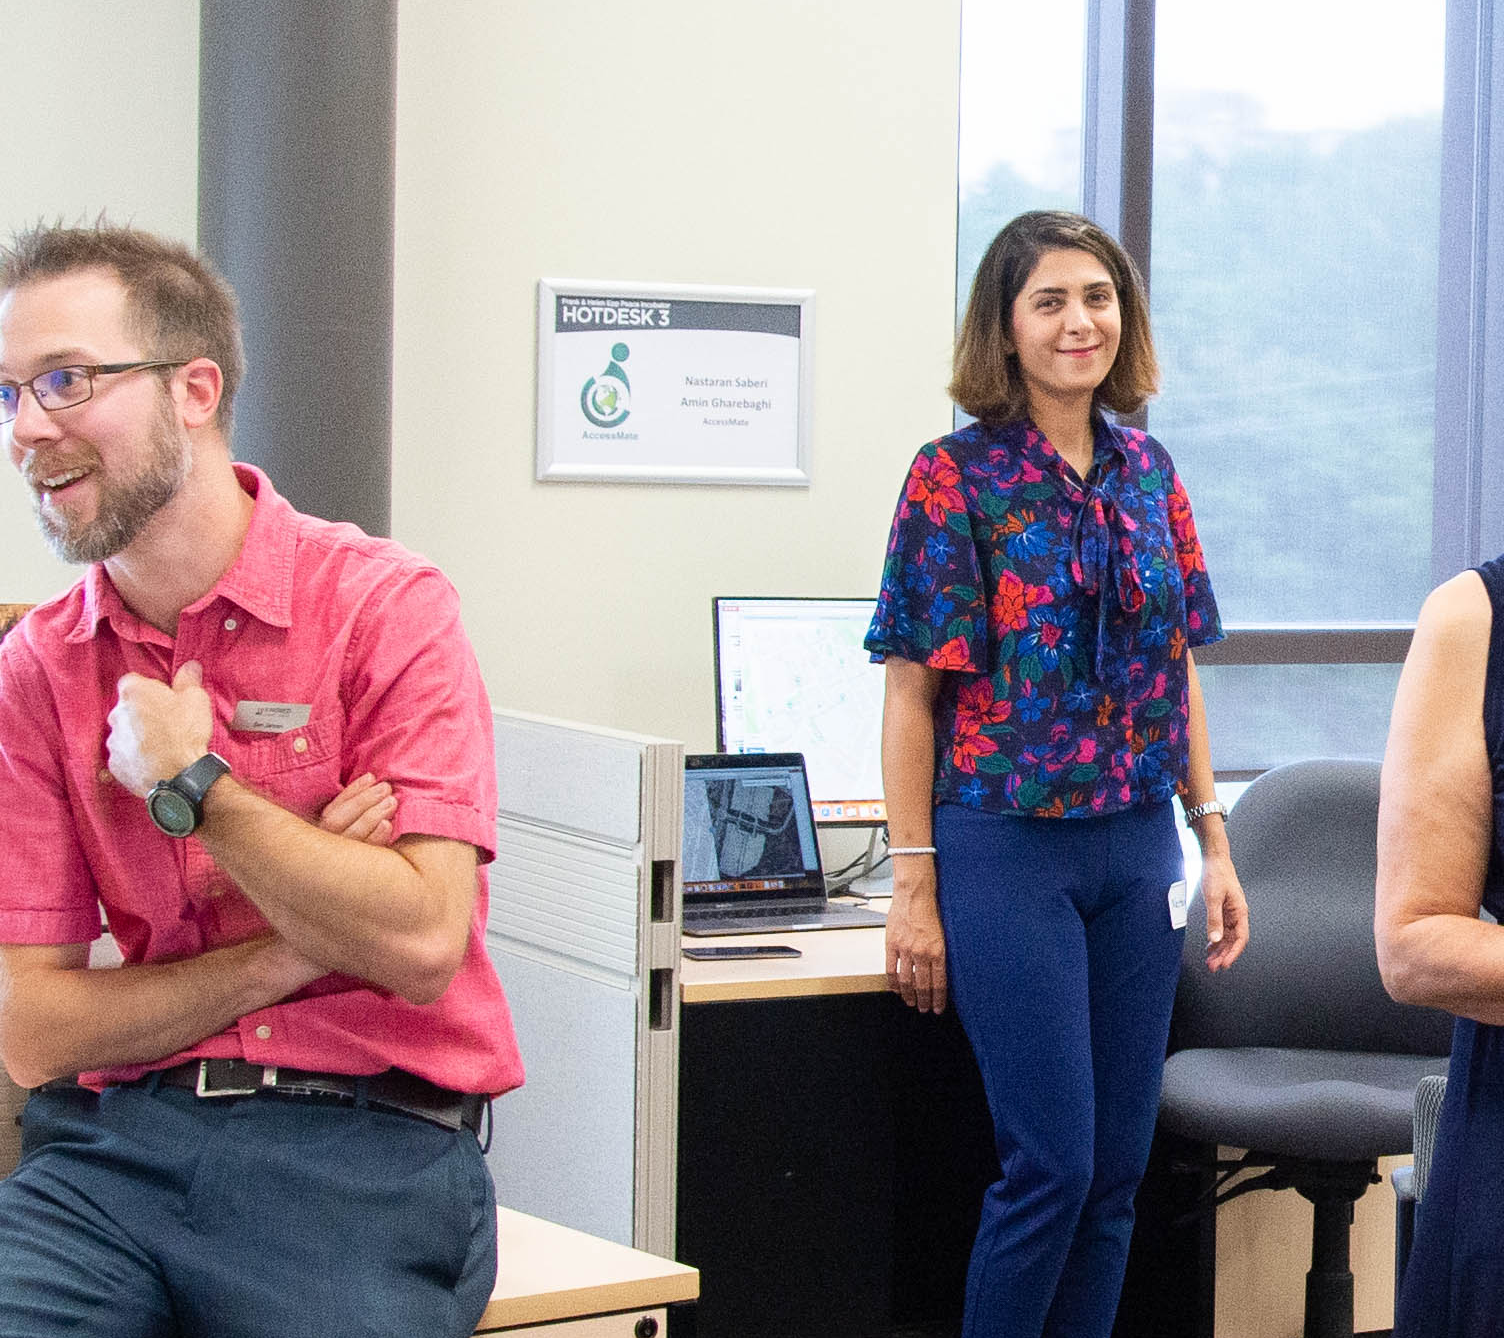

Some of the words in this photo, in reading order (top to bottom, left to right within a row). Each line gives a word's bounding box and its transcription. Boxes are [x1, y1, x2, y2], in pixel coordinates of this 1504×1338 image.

[562, 305, 655, 326] HOTDESK
[658, 309, 670, 326] 3
[685, 376, 732, 387] Nastaran
[735, 377, 768, 388] Saberi
[680, 397, 709, 407] Amin
[711, 397, 771, 411] Gharebaghi
